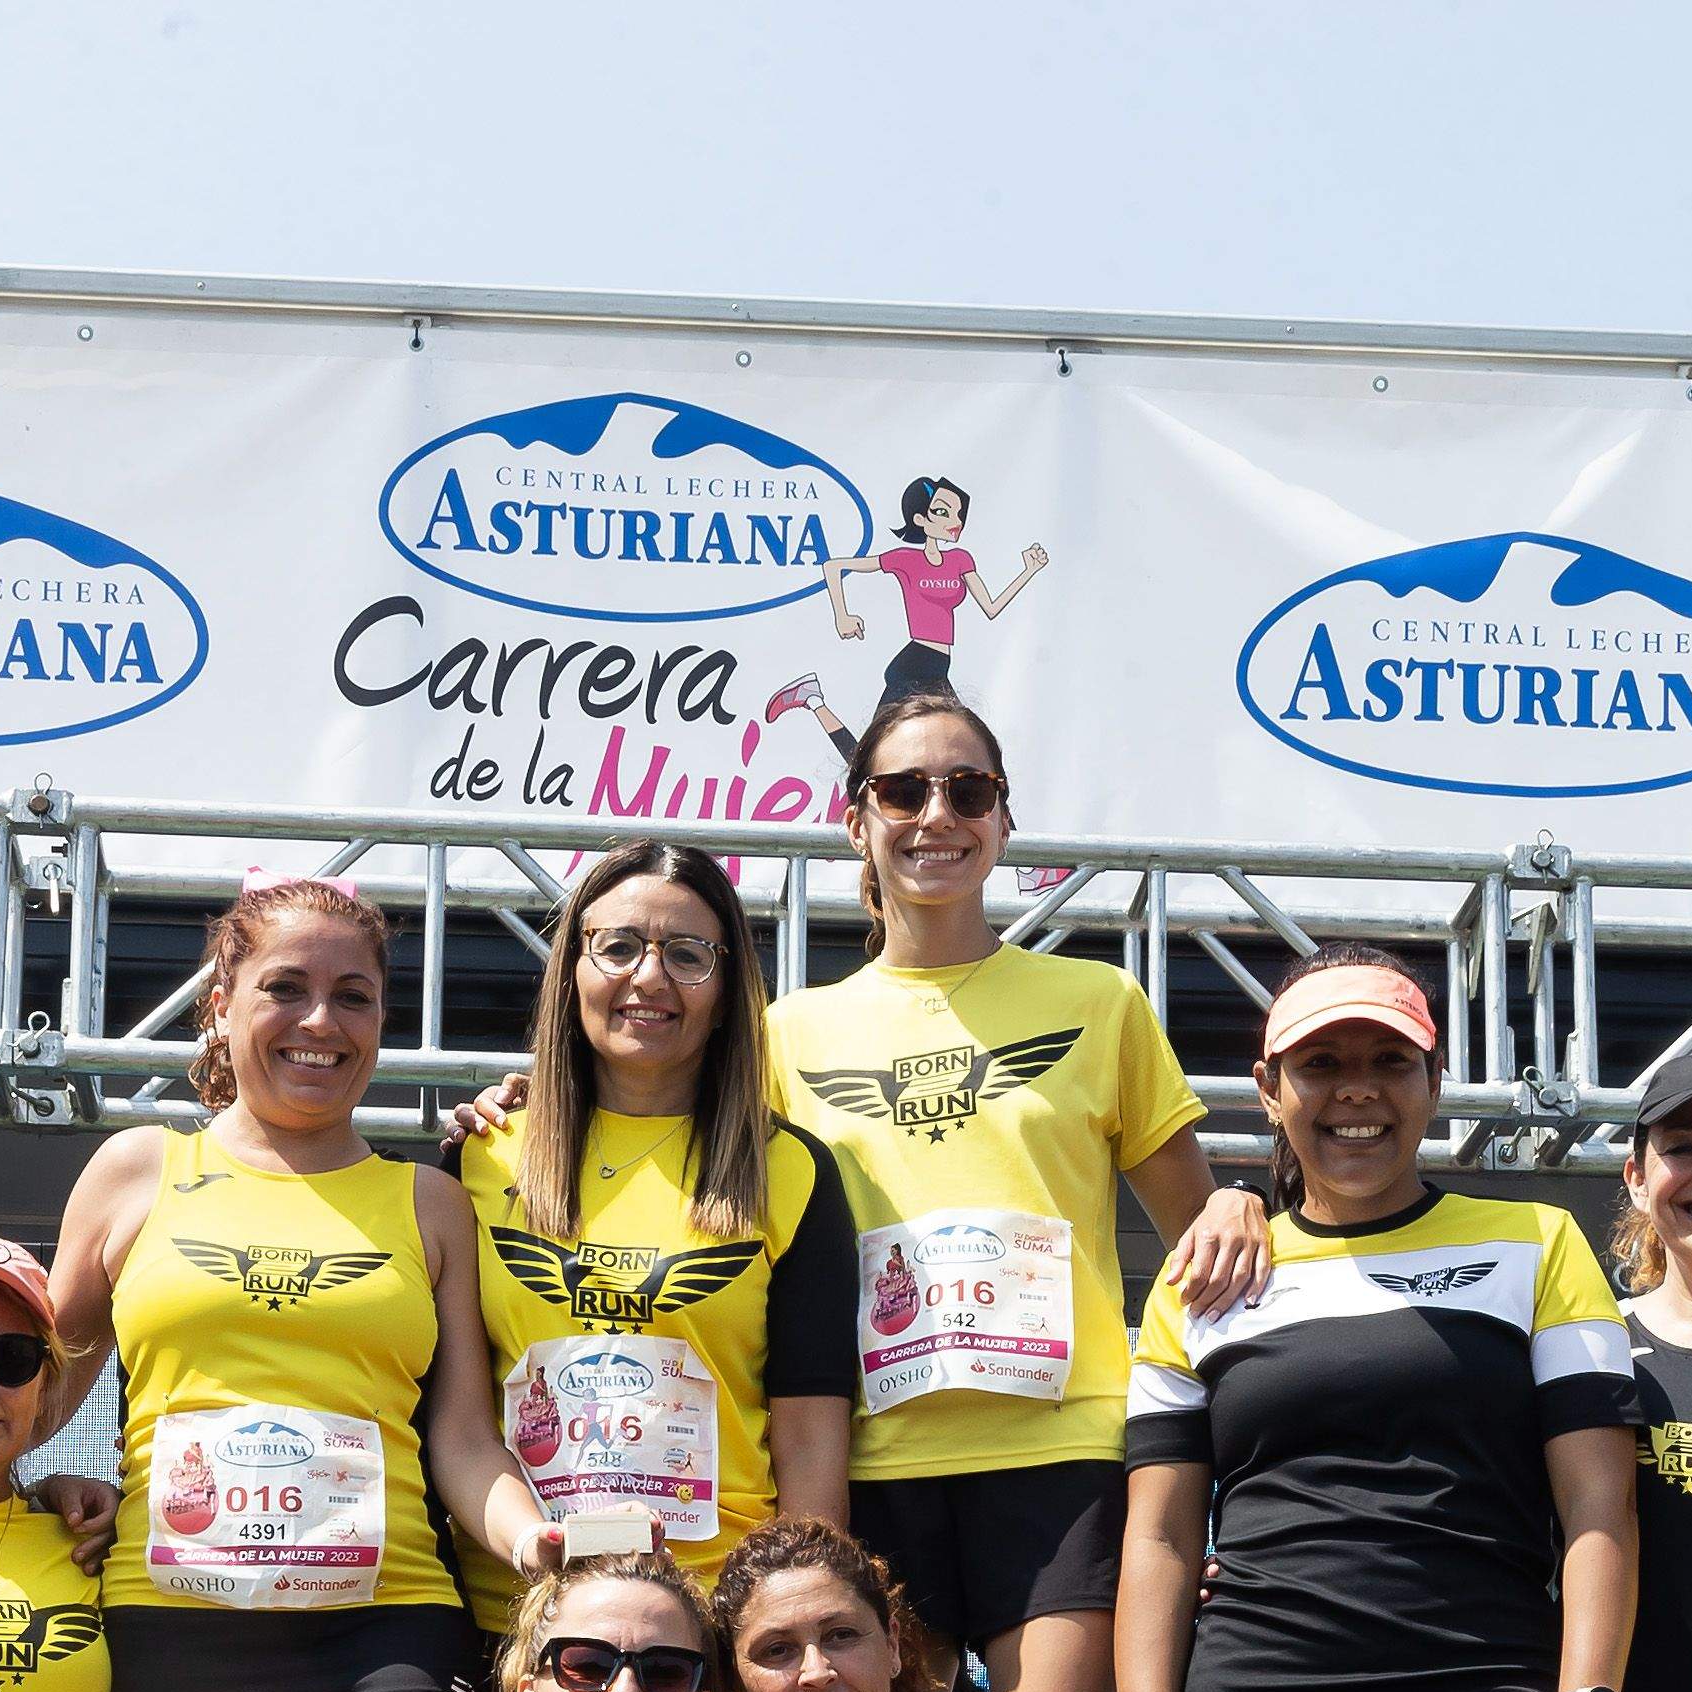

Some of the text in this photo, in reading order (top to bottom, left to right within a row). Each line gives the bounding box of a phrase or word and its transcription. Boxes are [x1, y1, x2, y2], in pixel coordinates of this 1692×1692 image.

[496, 466, 820, 500] CENTRAL LECHERA
[416, 467, 832, 568] ASTURIANA
[919, 579, 961, 589] OYSHO
[1372, 617, 1548, 648] CENTRAL
[332, 594, 737, 725] Carrera
[430, 722, 503, 802] de
[525, 727, 575, 808] la
[900, 1050, 969, 1078] BORN
[900, 1090, 972, 1121] RUN
[251, 1248, 308, 1263] BORN
[1013, 1240, 1053, 1254] SUMA
[582, 1247, 651, 1270] BORN
[248, 1274, 308, 1293] RUN
[925, 1279, 995, 1307] 016
[578, 1291, 647, 1318] RUN
[942, 1313, 976, 1328] 542
[880, 1335, 1051, 1363] CARRERA DE LA MUJER 2023
[565, 1371, 646, 1389] ASTURIANA
[879, 1365, 933, 1393] OYSHO
[989, 1363, 1054, 1382] Santander
[324, 1437, 365, 1450] SUMA
[226, 1485, 303, 1512] 016
[658, 1508, 700, 1524] tander
[239, 1523, 286, 1540] 4391
[239, 1551, 256, 1561] DE
[258, 1550, 277, 1561] LA
[279, 1550, 325, 1562] MUJER
[330, 1551, 360, 1562] 2023
[170, 1576, 235, 1593] OYSHO
[292, 1578, 361, 1591] Santander
